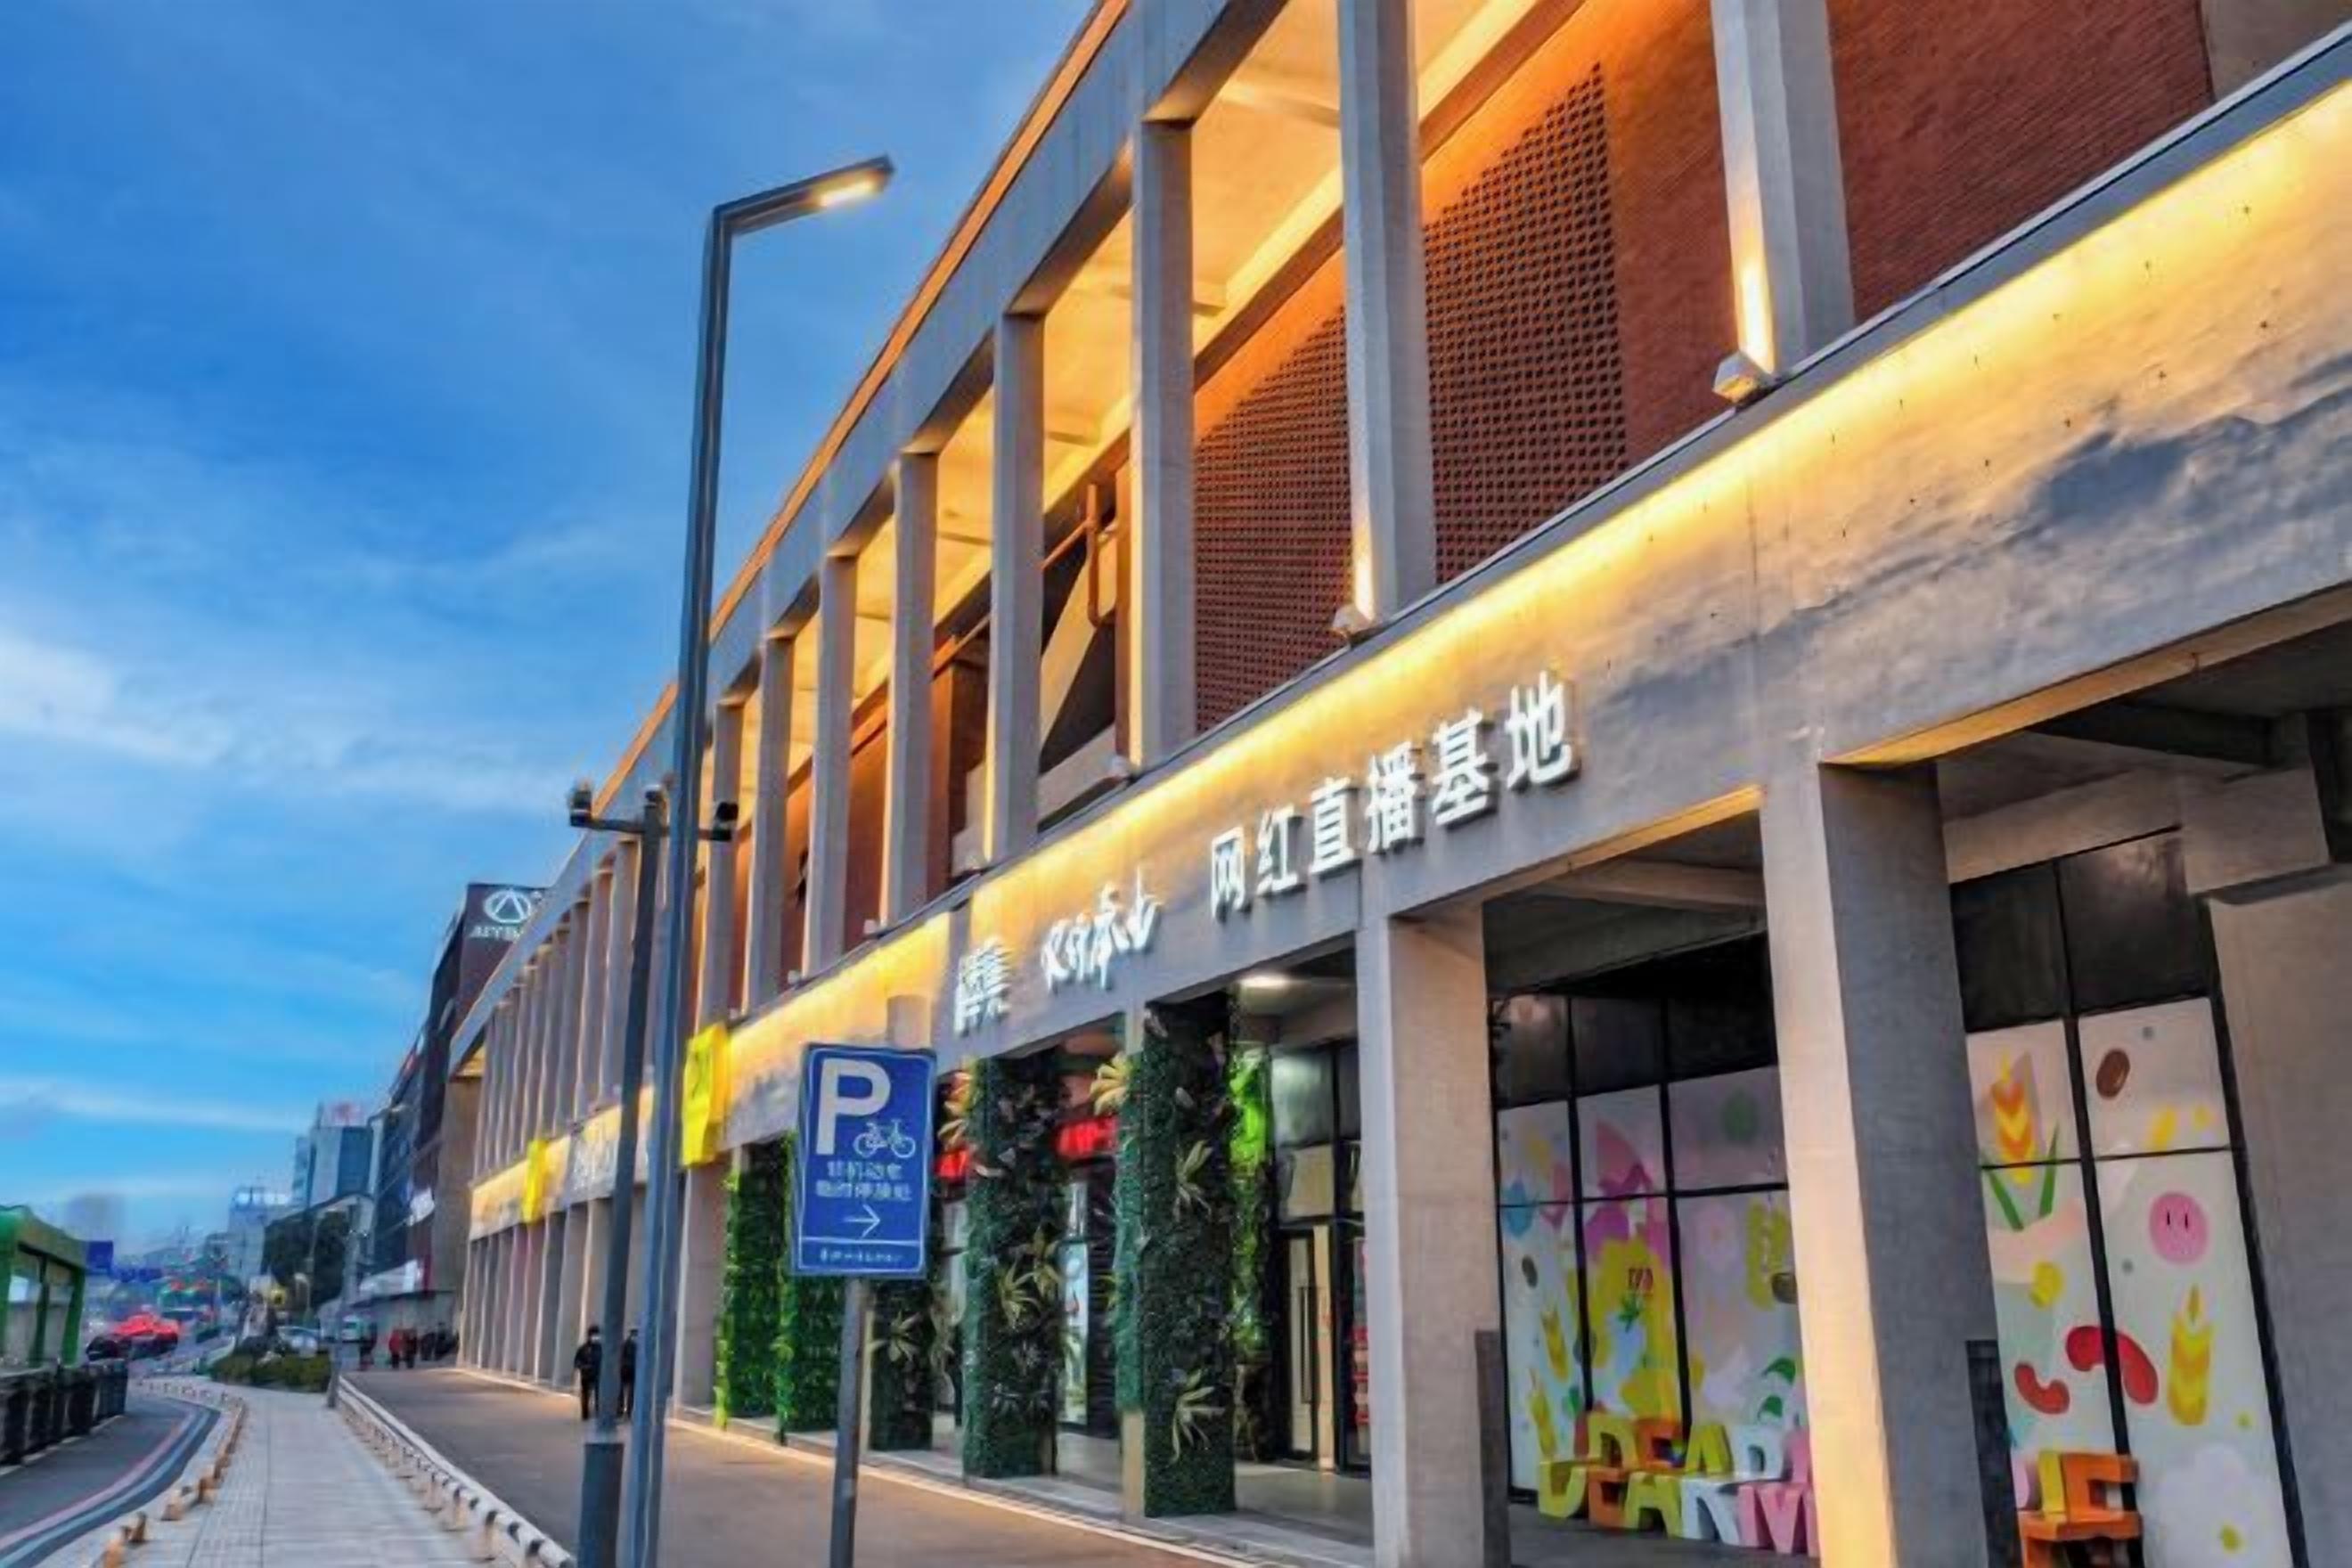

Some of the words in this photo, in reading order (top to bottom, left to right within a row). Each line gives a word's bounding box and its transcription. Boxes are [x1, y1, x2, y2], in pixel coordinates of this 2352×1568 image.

[1211, 670, 1576, 922] 网红直播基地
[816, 1058, 891, 1156] P
